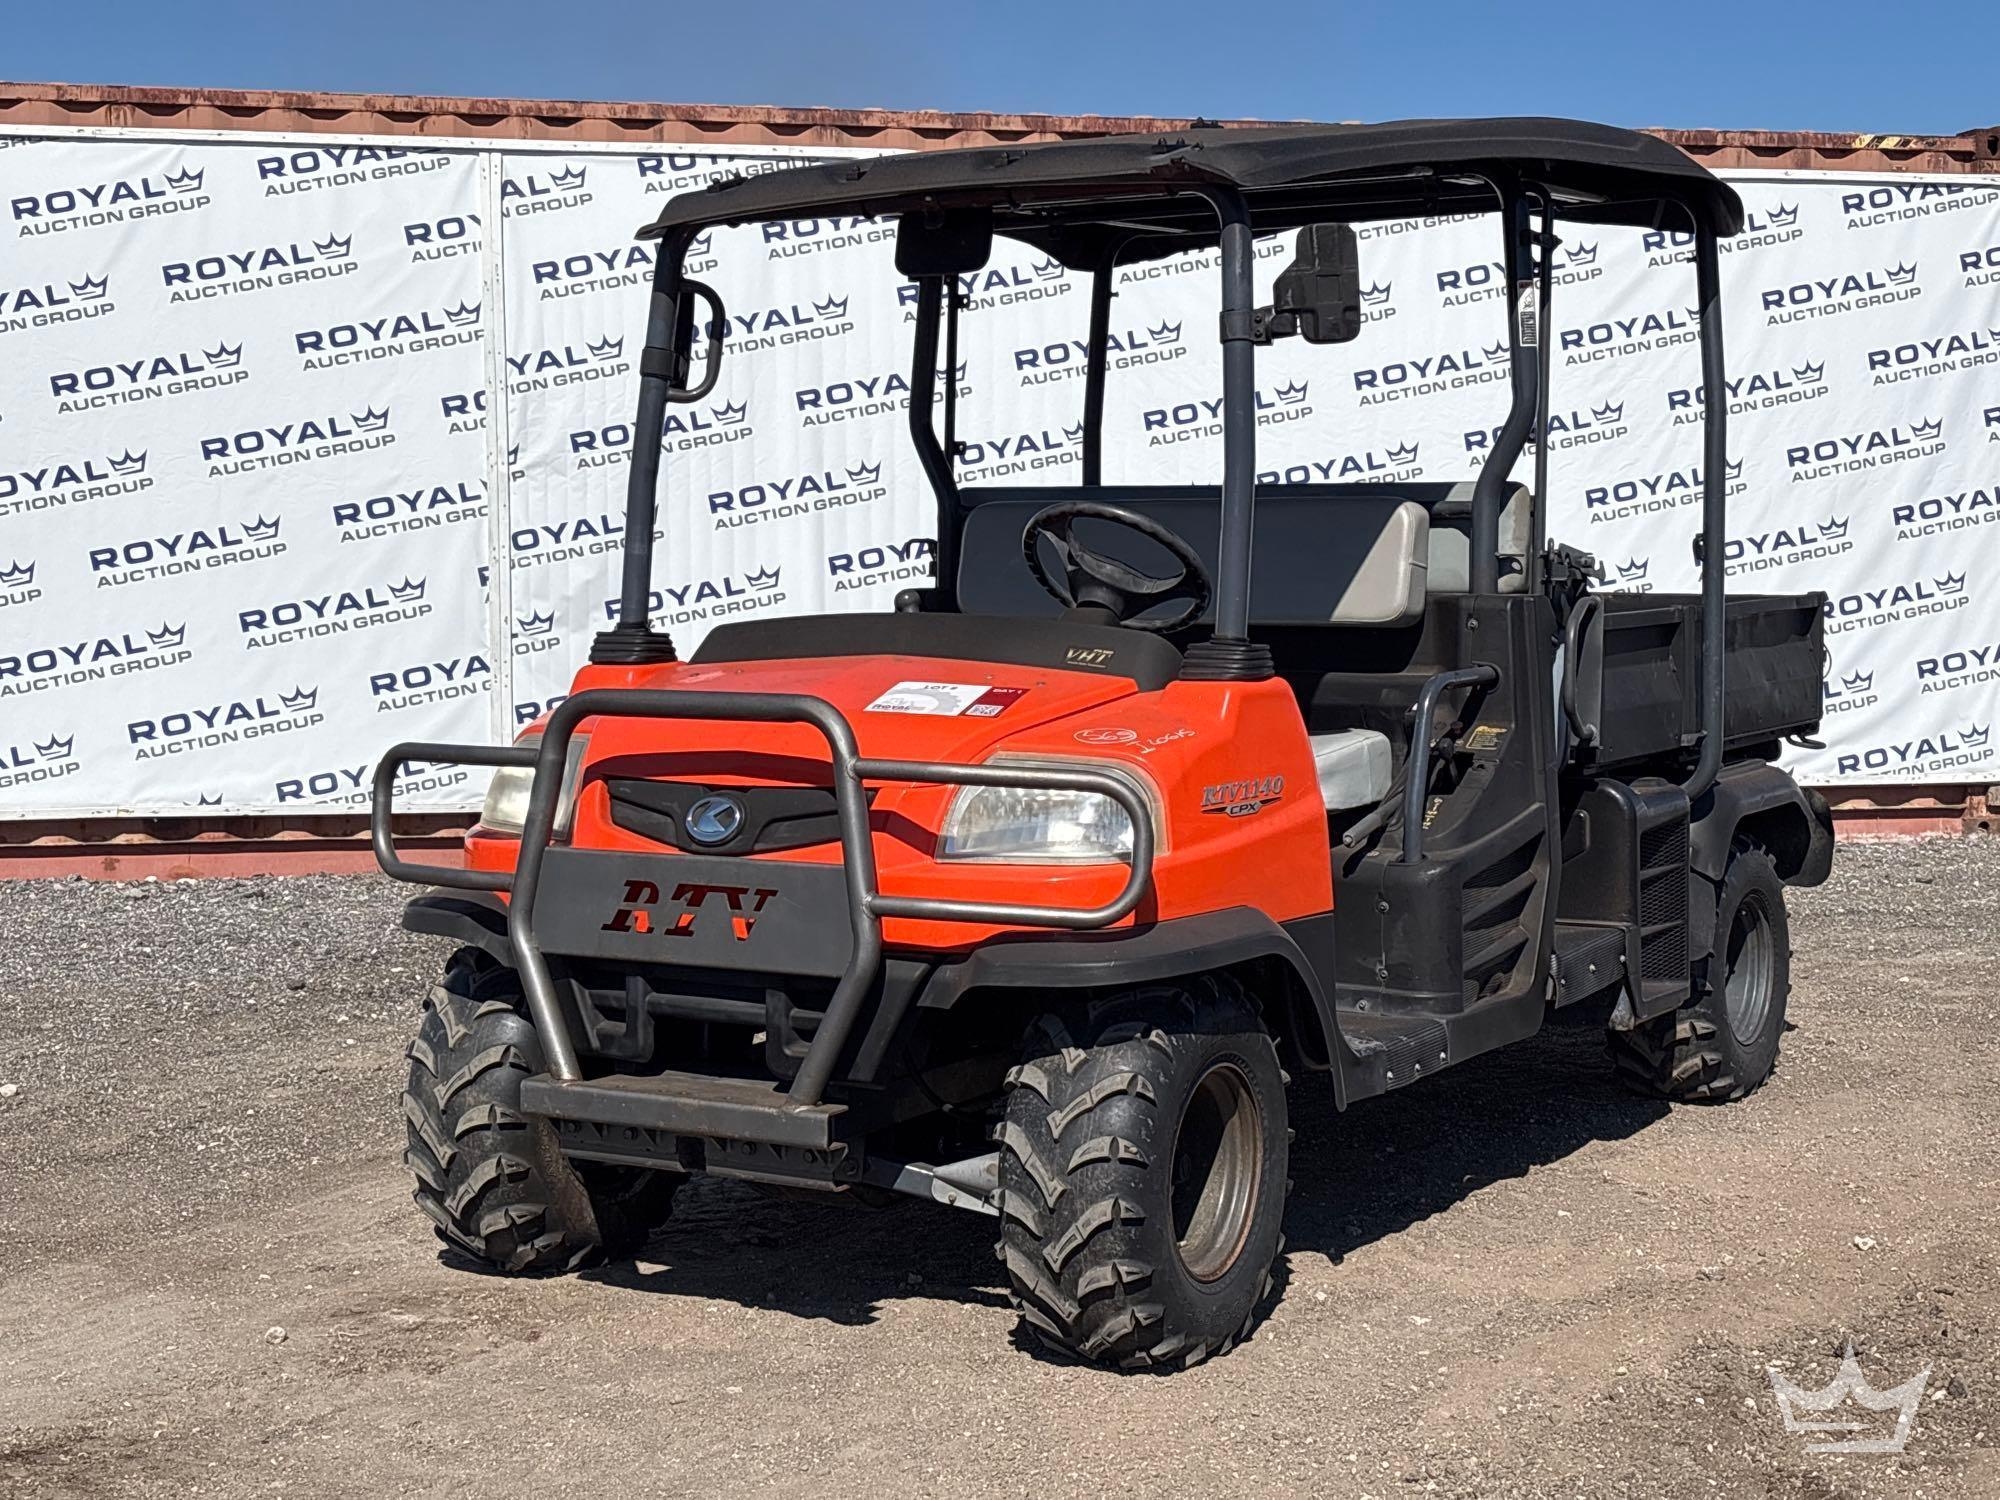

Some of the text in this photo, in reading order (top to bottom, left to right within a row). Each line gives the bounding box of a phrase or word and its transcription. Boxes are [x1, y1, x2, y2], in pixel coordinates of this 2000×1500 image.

[265, 157, 451, 197] AUCTION GROUP
[11, 176, 167, 221] ROYAL
[19, 195, 211, 238] AUCTION GROUP
[516, 193, 592, 216] GROUP
[1847, 192, 2000, 230] AUCTION GROUP
[768, 229, 862, 260] AUCTION
[1359, 218, 1419, 240] CTION
[1736, 229, 1803, 250] GROUP
[163, 242, 315, 287] ROYAL
[412, 241, 482, 263] AUCTI
[533, 243, 660, 284] ROYA
[170, 261, 358, 304] AUCTION GROUP
[540, 273, 637, 301] AUCTION
[897, 267, 1032, 306] RYAL
[1120, 259, 1209, 284] AUCTION
[999, 283, 1071, 305] GROUP
[1762, 272, 1885, 310] ROYAL
[1767, 287, 1921, 326] AUCTION GROUP
[32, 302, 115, 328] GROUP
[295, 310, 444, 354] ROYAL
[780, 322, 854, 345] GROUP
[1560, 310, 1686, 350] ROYAL
[303, 341, 404, 371] AUCTION
[506, 346, 588, 376] YAL
[1116, 347, 1187, 371] GROUP
[1566, 330, 1701, 366] AUCTION GRO
[1868, 332, 1989, 370] ROYAL
[50, 352, 204, 397] ROYAL
[553, 363, 630, 387] GROUP
[1354, 351, 1482, 390] ROYAL
[1359, 367, 1512, 407] AUCTION GROU
[1873, 352, 2000, 386] AUCTION GRO
[57, 370, 249, 414] AUCTION GROUP
[795, 373, 910, 411] ROYA
[1144, 391, 1275, 431] ROYL
[1762, 386, 1829, 408] GROUP
[570, 411, 712, 453] ROAL
[803, 400, 895, 427] AUCTION
[1149, 407, 1313, 447] AUCTIO ROUP
[201, 416, 352, 461] ROYAL
[208, 434, 396, 478] AUCTION GROUP
[577, 427, 753, 470] AUCTN GROUP
[960, 430, 1063, 465] OYAL
[1560, 426, 1628, 449] GROUP
[1787, 428, 1911, 467] ROYAL
[0, 461, 109, 498] OYAL
[957, 451, 1083, 483] CTION GROU
[1792, 443, 1946, 483] AUCTION GROUP
[0, 478, 153, 516] CTION GROUP
[333, 482, 482, 526] ROYAL
[708, 472, 846, 514] ROYAL
[715, 488, 886, 531] AUCTION GROUP
[1591, 498, 1676, 524] AUCTION
[341, 505, 488, 543] AUCTION GRO
[512, 514, 624, 551] OYAL
[1897, 511, 1979, 541] AUCTION
[89, 525, 243, 572] ROYAL
[97, 542, 287, 589] AUCTION GROUP
[511, 546, 584, 570] CTION
[1696, 527, 1818, 566] OYAL
[1788, 541, 1853, 563] GROUP
[835, 564, 927, 592] AUCTION
[239, 587, 389, 633] ROYAL
[712, 592, 786, 617] GROUP
[1904, 596, 1969, 619] GROUP
[246, 603, 432, 650] AUCTION GROUP
[0, 635, 147, 679] ROYAL
[1, 651, 192, 697] AUCTION GROUP
[1066, 648, 1114, 664] VHT
[1917, 645, 2000, 679] ROY
[370, 656, 490, 696] ROYA
[377, 683, 477, 712] AUCTION
[1825, 695, 1878, 714] ROUP
[128, 697, 280, 744] ROYAL
[135, 713, 324, 761] AUCTION GROUP
[1838, 735, 1958, 775] ROYAL
[1929, 749, 1993, 771] GROUP
[0, 762, 80, 788] GROUP
[276, 760, 425, 803] ROYL
[392, 772, 468, 797] GROUP
[1201, 775, 1284, 806] RTV1140
[1230, 803, 1257, 815] CPX
[601, 879, 779, 942] RTV
